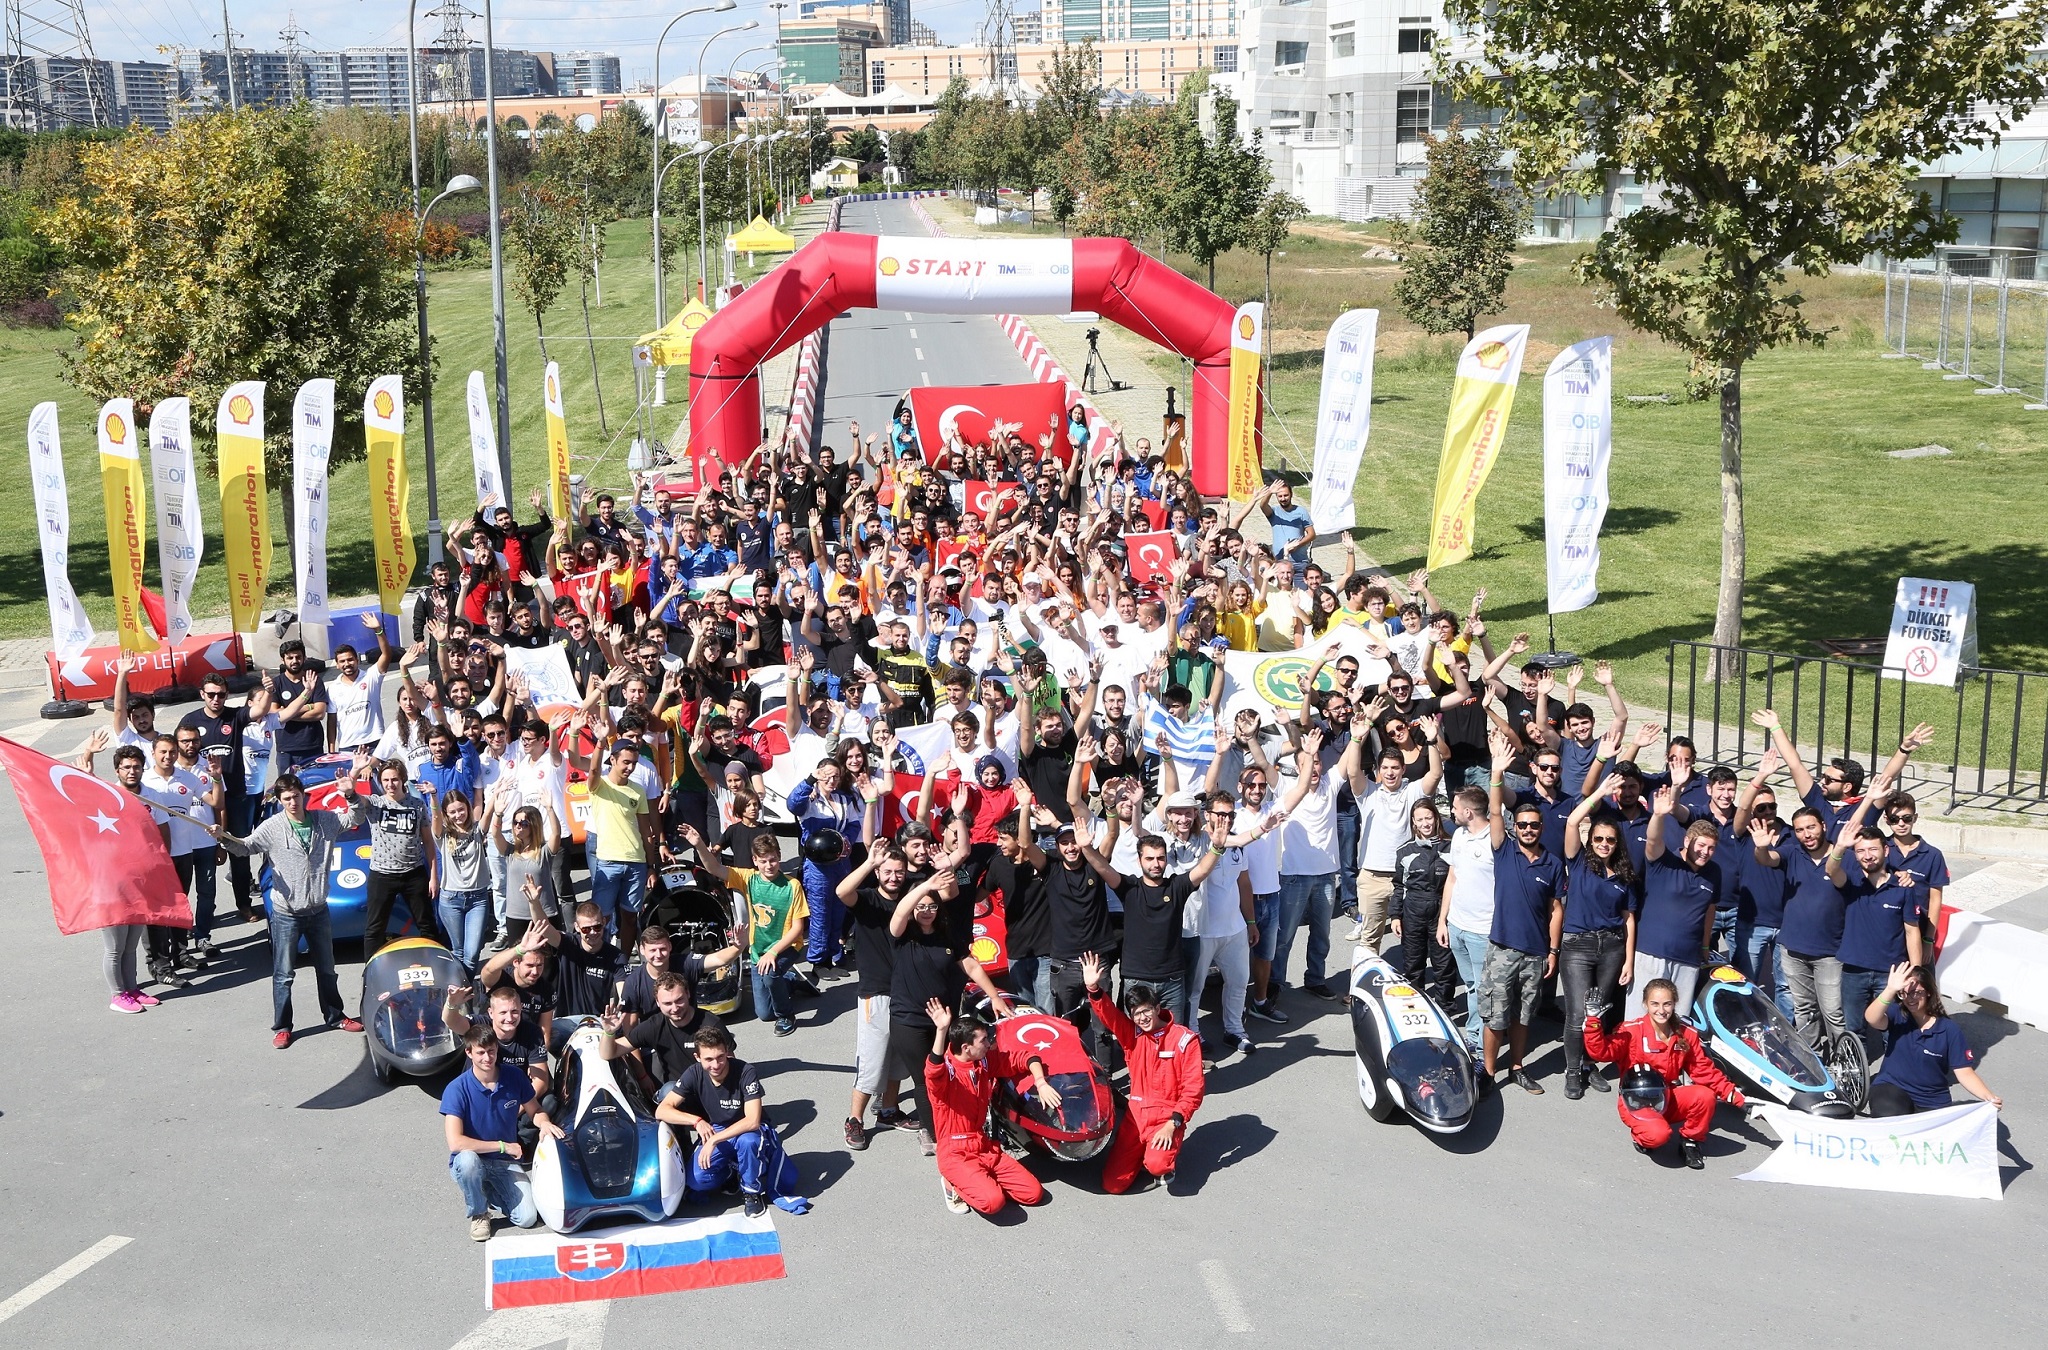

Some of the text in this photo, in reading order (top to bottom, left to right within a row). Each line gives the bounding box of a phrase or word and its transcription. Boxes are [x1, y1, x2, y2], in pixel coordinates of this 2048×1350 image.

[906, 259, 986, 276] START
[1564, 380, 1589, 395] TIM
[304, 412, 322, 427] TIM
[1331, 410, 1351, 424] TIM
[1571, 412, 1600, 430] OiB
[161, 435, 180, 451] TIM
[310, 443, 328, 460] OiB
[1566, 463, 1590, 477] TIM
[1234, 465, 1242, 493] Shell
[1564, 545, 1589, 559] TIM
[382, 559, 396, 591] Shell
[237, 572, 251, 607] Shell
[122, 595, 134, 631] Shell
[1906, 609, 1953, 628] DİKKAT
[103, 651, 189, 676] KP LEFT
[403, 970, 429, 981] 339
[1402, 1014, 1430, 1026] 332
[585, 1035, 601, 1044] 31
[1794, 1130, 1969, 1166] HiDRANA
